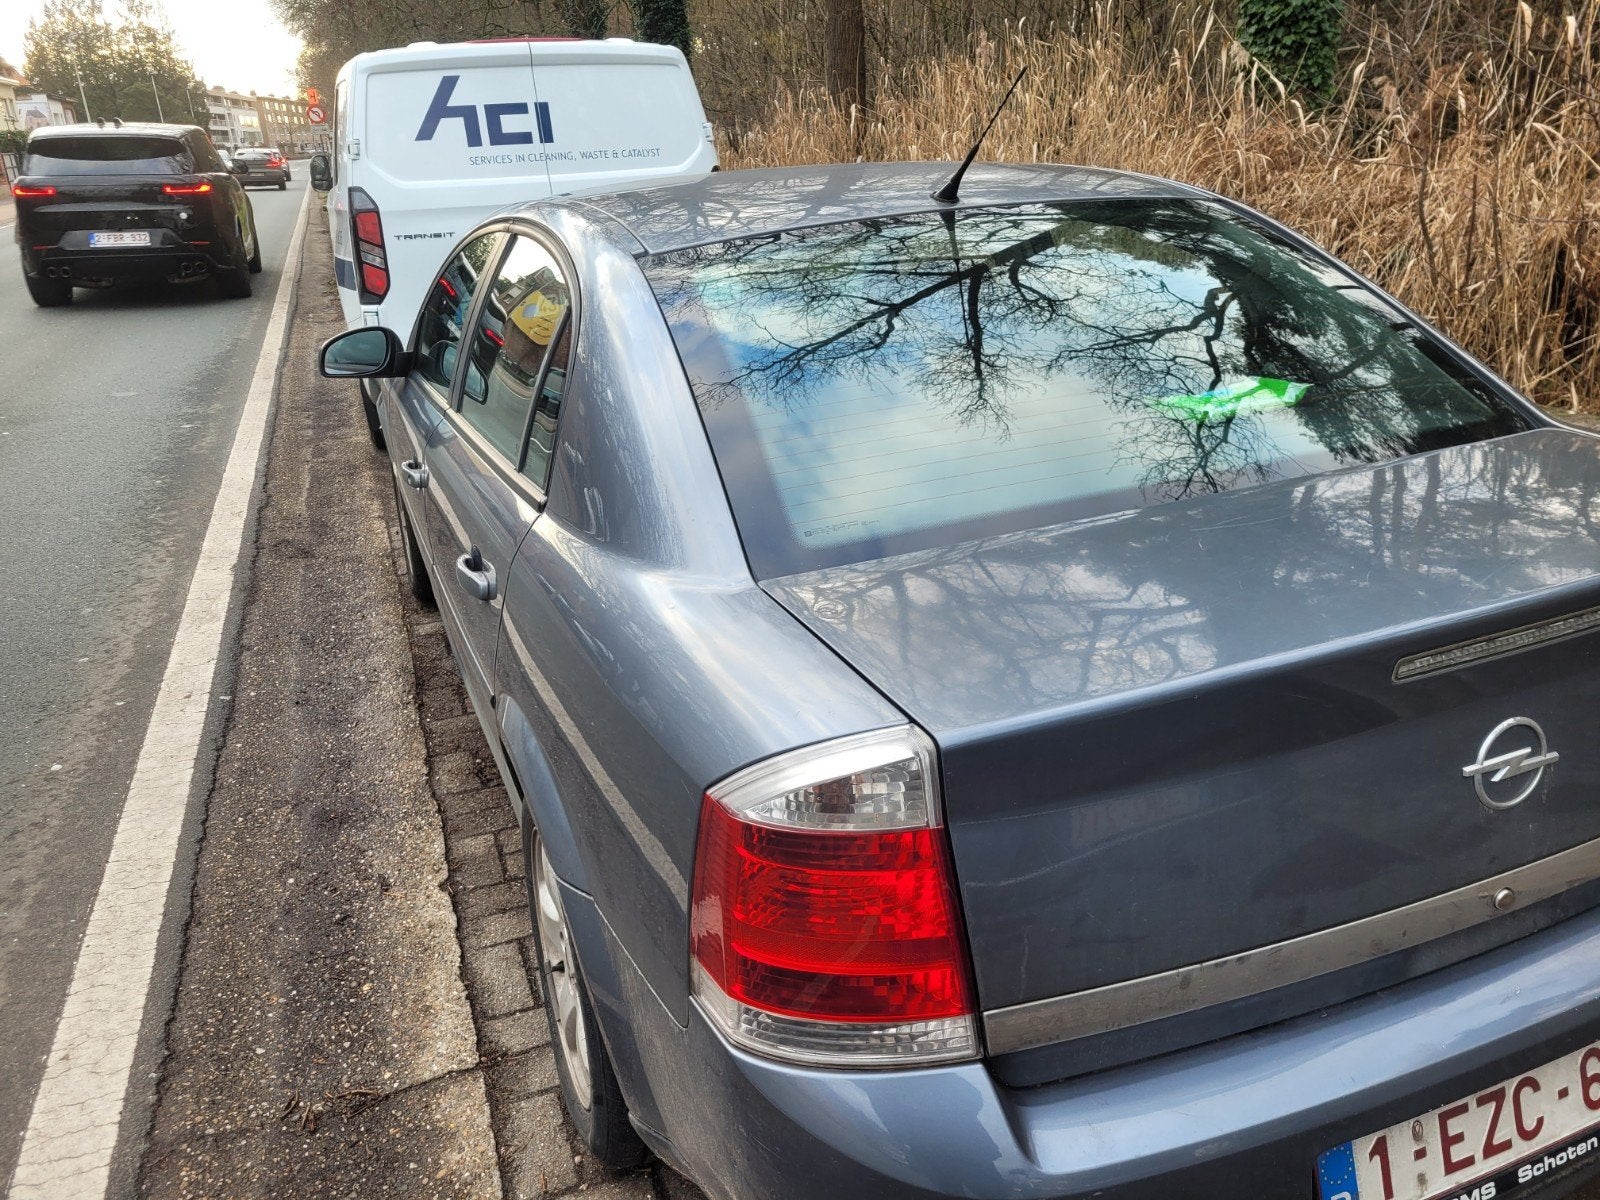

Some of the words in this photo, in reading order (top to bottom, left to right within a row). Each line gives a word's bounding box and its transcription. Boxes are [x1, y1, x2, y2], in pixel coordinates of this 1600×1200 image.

[469, 155, 513, 166] SERVICES
[515, 154, 525, 163] IN
[527, 151, 577, 163] CLEANING,
[579, 149, 610, 160] WASTE
[611, 149, 620, 158] &
[621, 148, 661, 158] CATALYST
[394, 231, 455, 240] TRANSIT
[1517, 1136, 1599, 1184] Schoten
